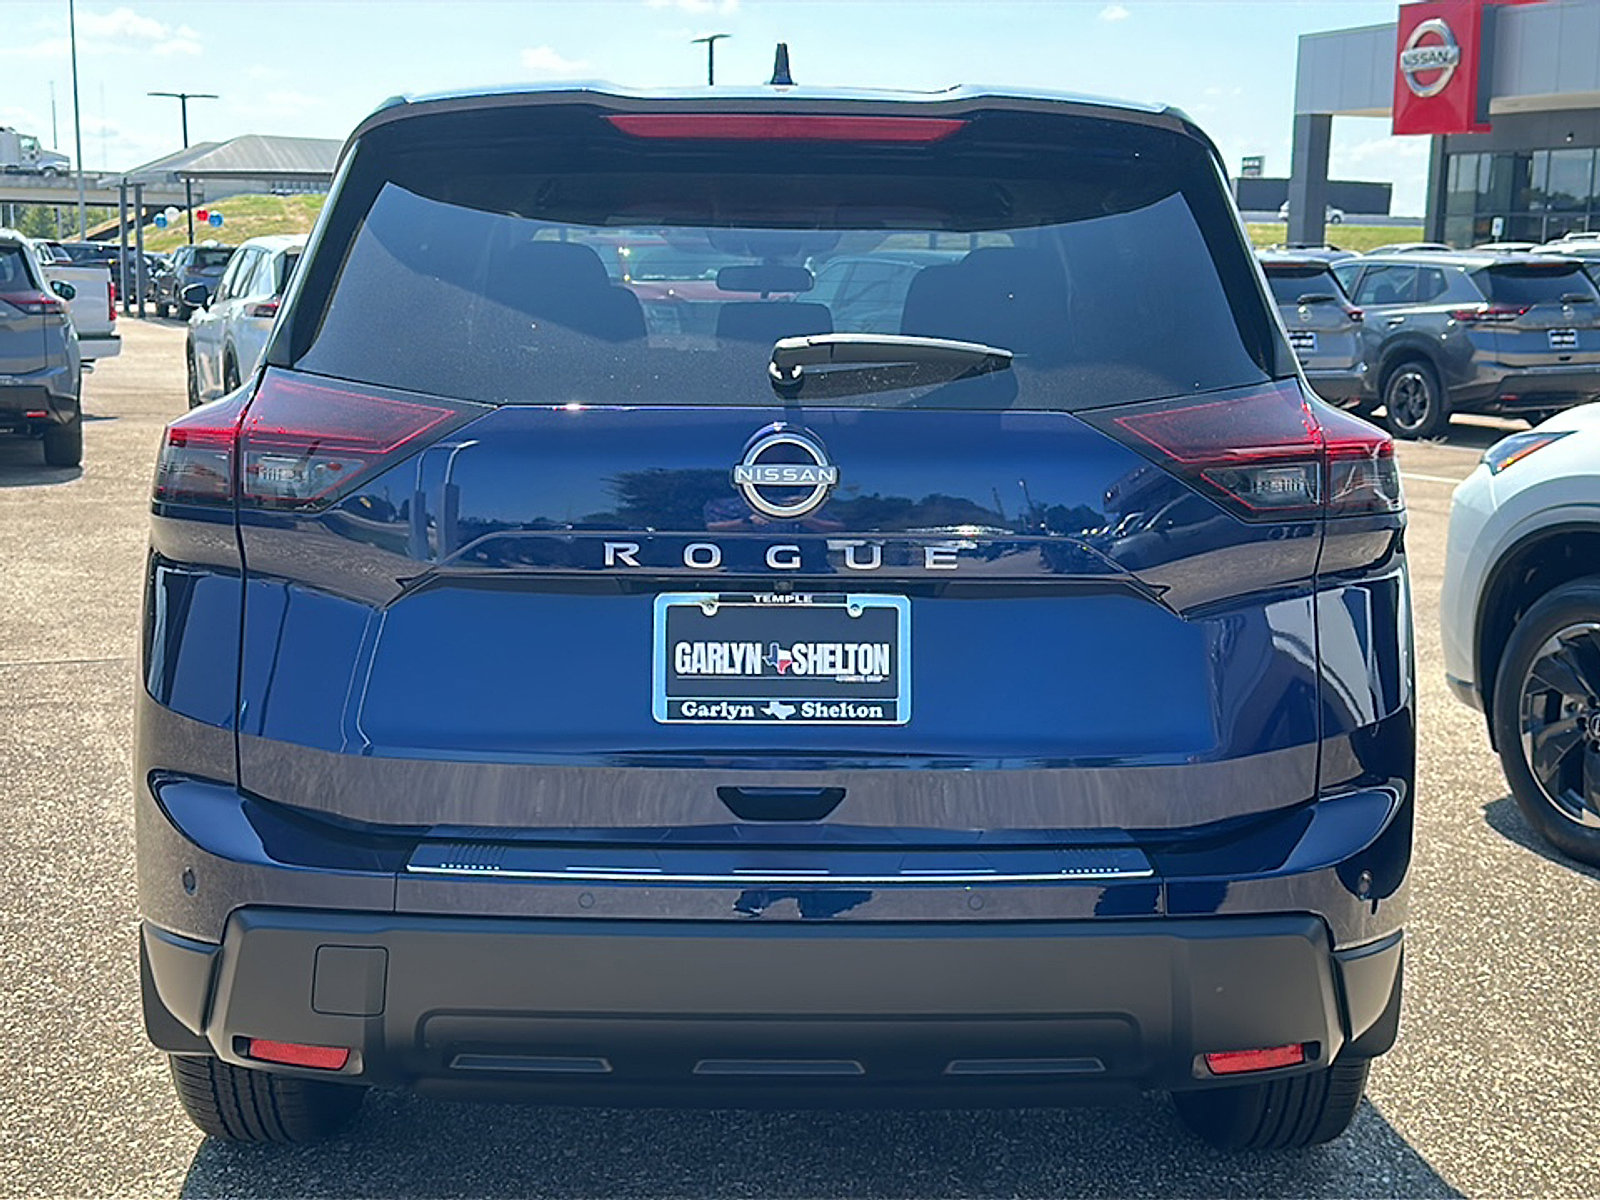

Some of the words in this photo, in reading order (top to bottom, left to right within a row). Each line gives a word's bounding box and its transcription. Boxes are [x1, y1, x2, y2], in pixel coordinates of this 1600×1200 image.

[1403, 51, 1450, 65] NISSAN
[736, 467, 835, 483] NISSAN
[603, 541, 960, 570] ROGUE
[753, 594, 813, 604] TEMPLE
[675, 641, 762, 675] GARLYN
[791, 643, 890, 675] SHELTON
[681, 701, 755, 720] Garlyn
[801, 701, 884, 718] Shelton
